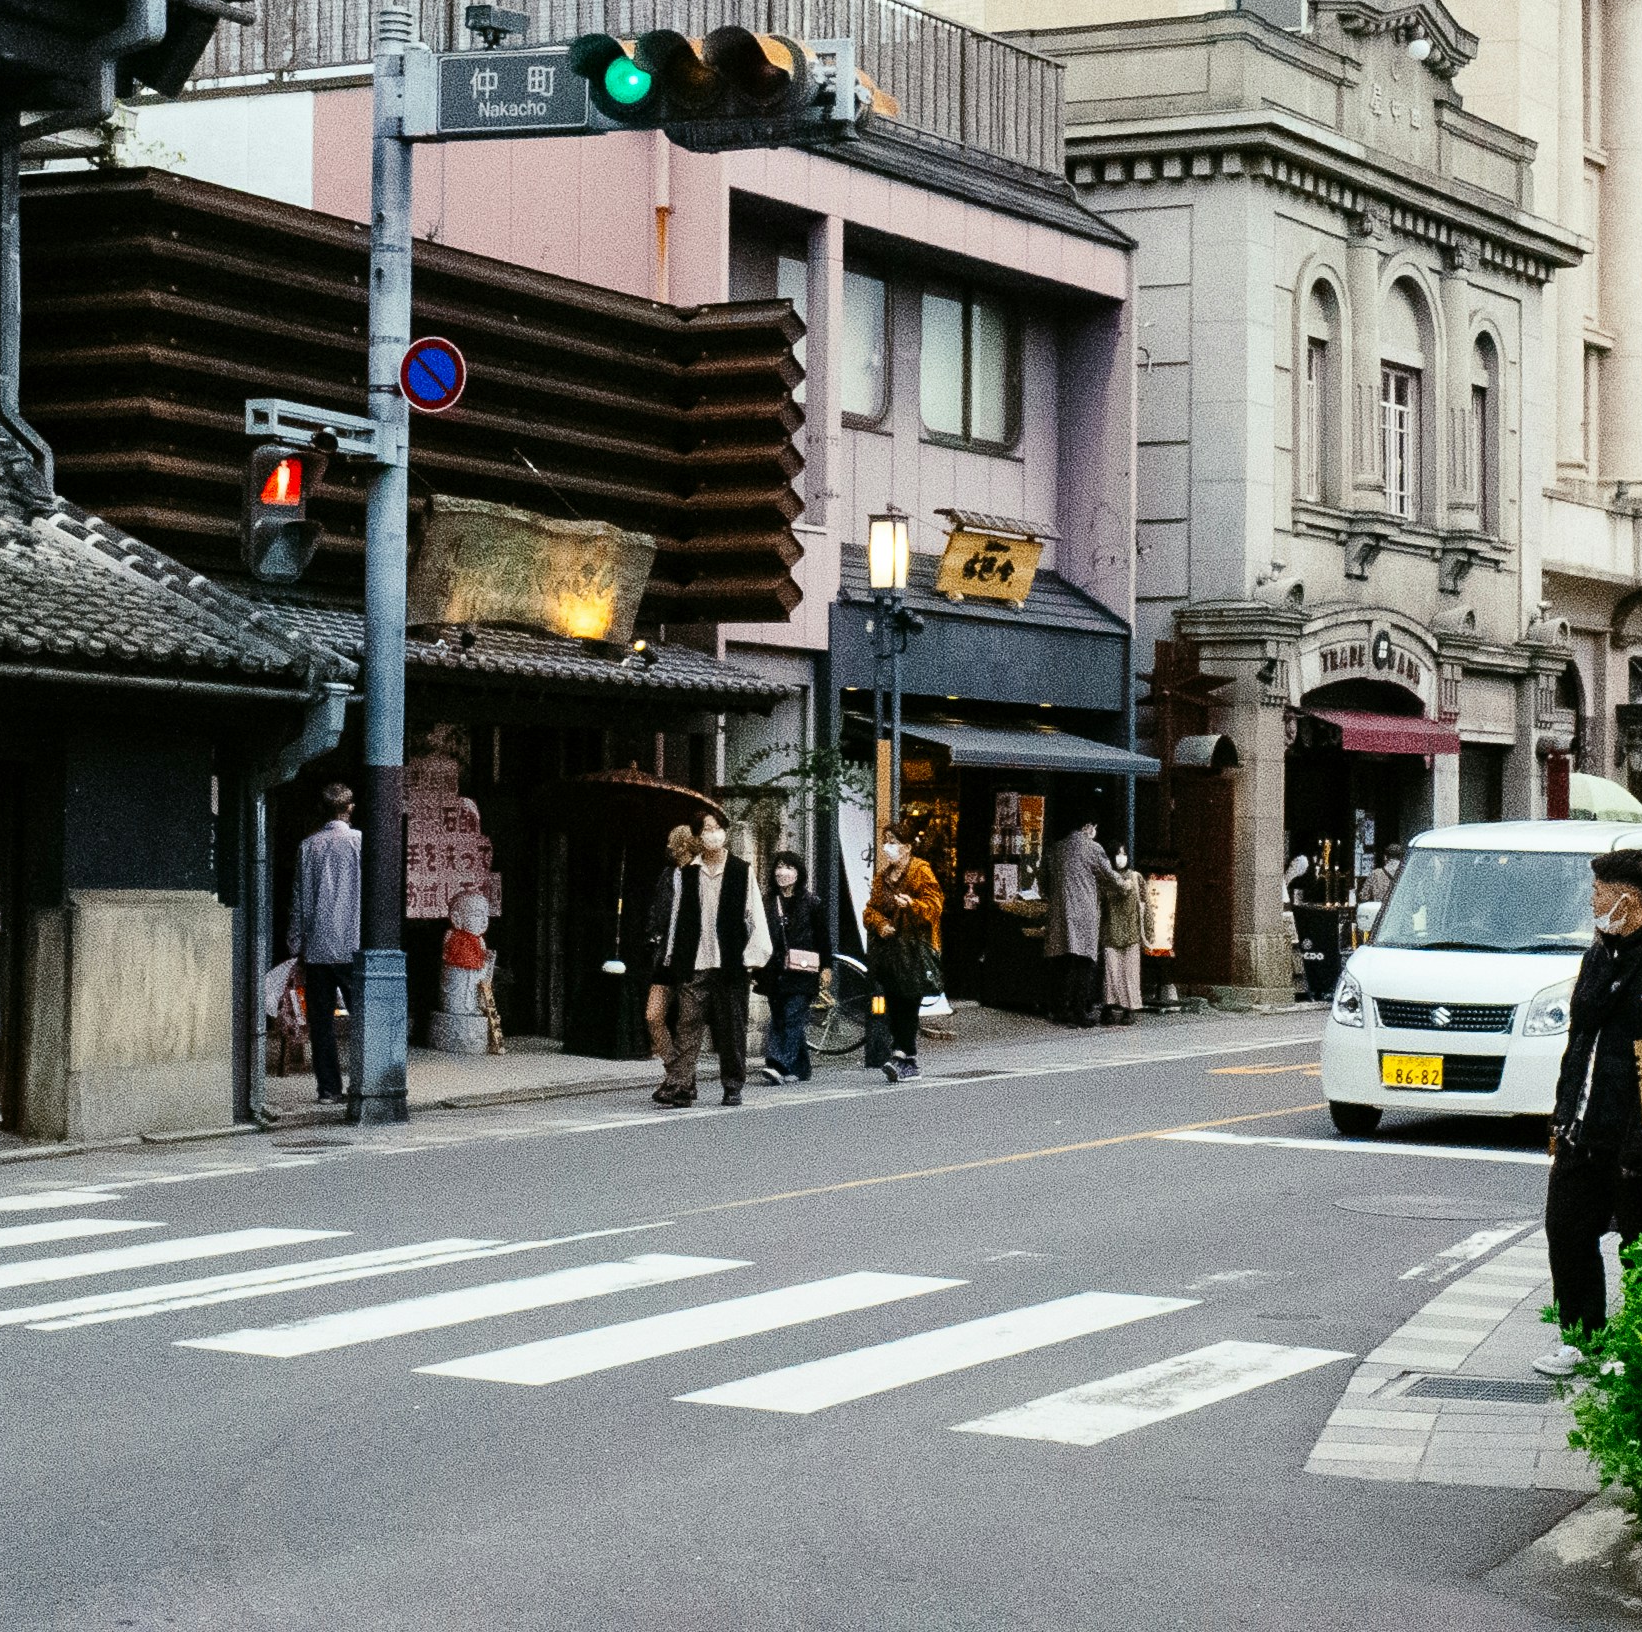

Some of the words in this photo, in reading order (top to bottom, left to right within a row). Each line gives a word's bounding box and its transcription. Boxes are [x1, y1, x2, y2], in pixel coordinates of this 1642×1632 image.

[470, 66, 555, 99] 仲町
[478, 100, 546, 118] Nakacho
[1396, 1068, 1440, 1086] 86-82
